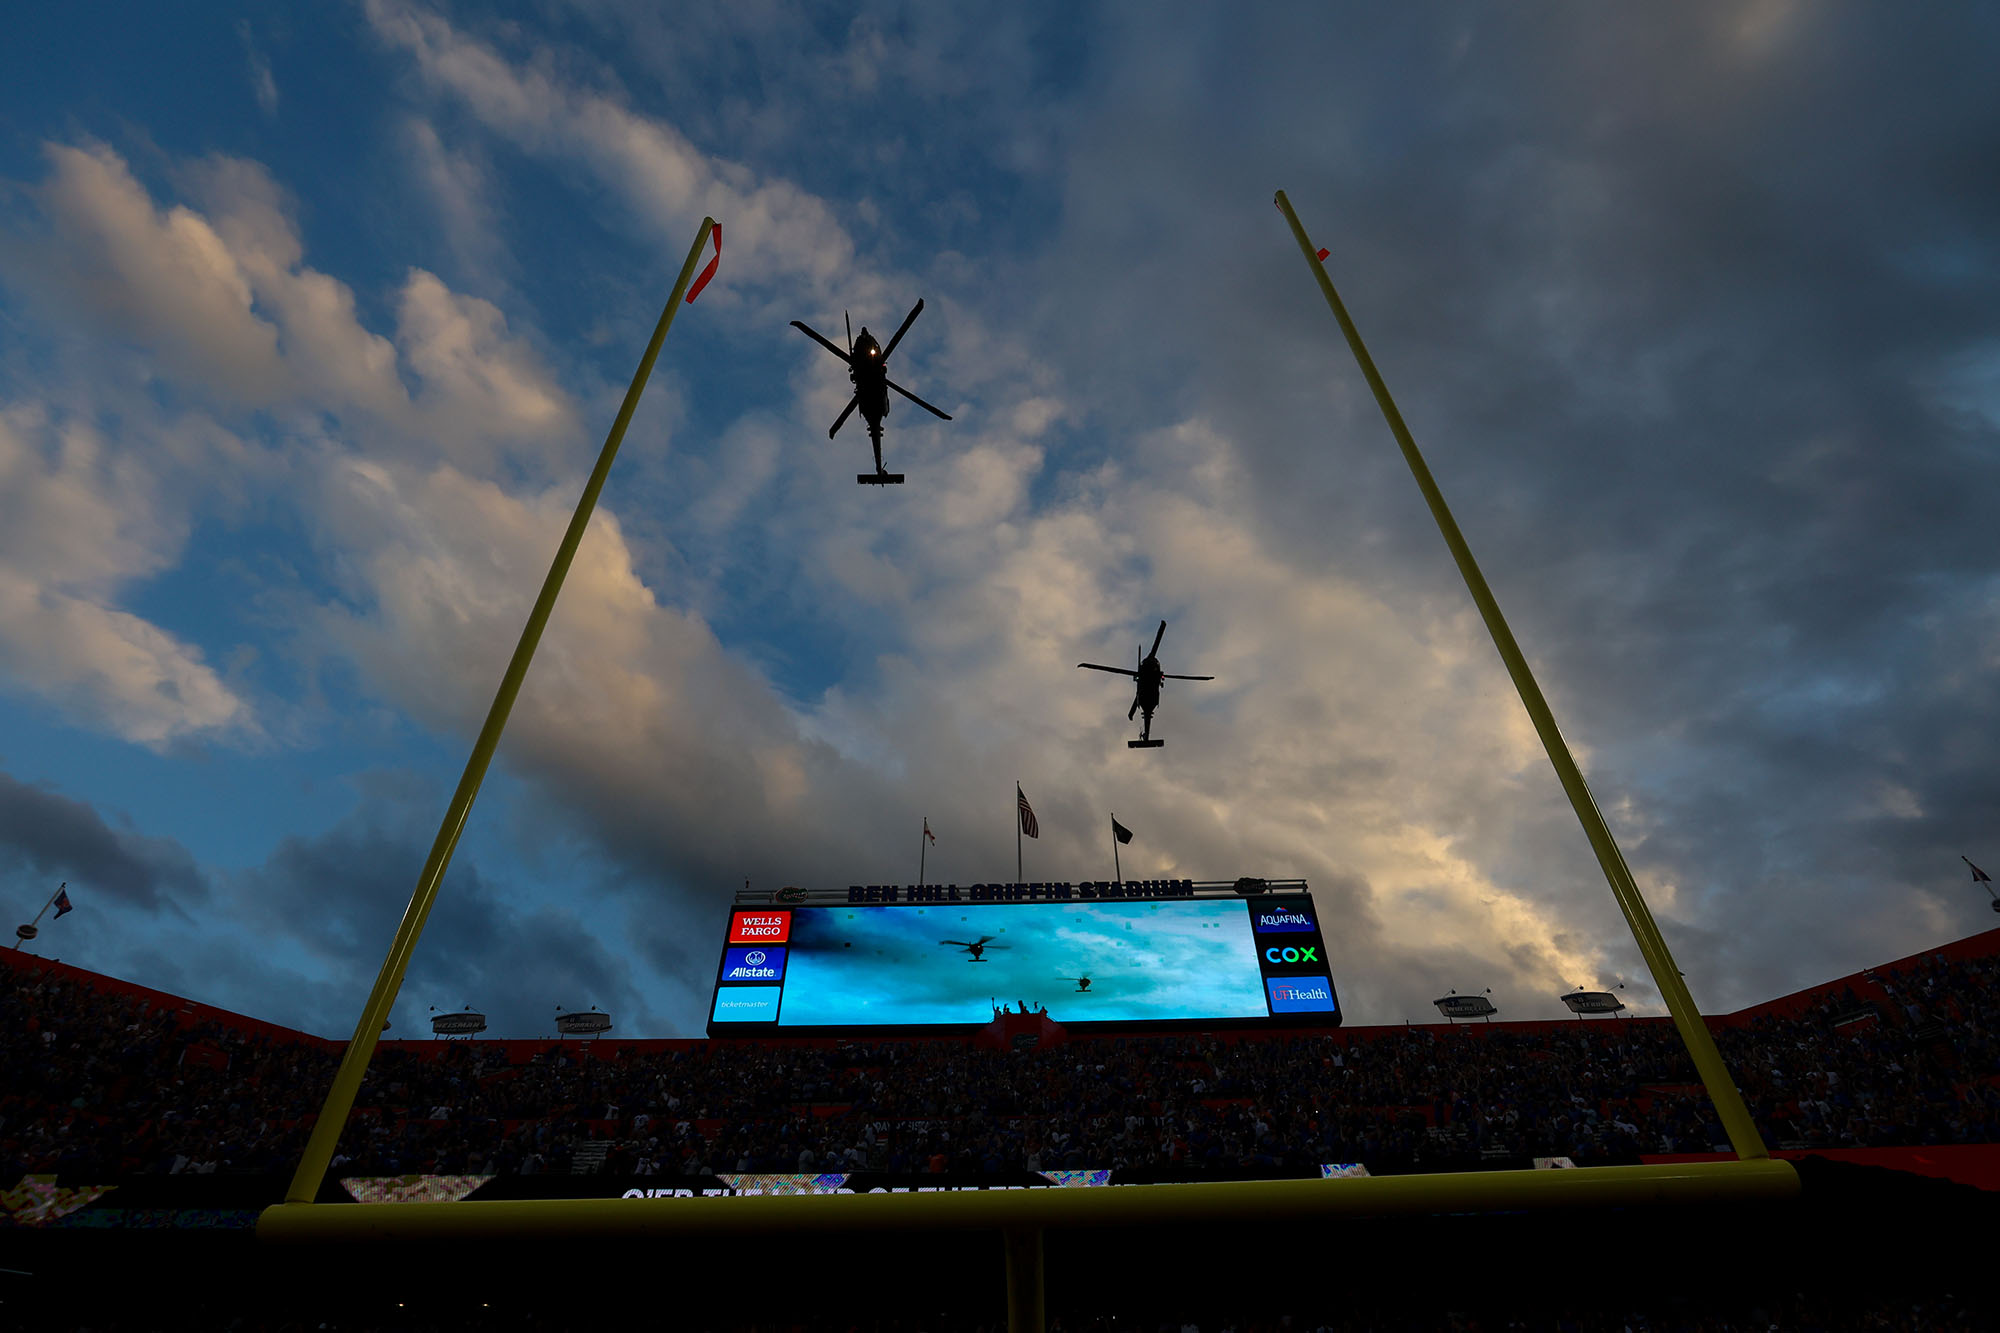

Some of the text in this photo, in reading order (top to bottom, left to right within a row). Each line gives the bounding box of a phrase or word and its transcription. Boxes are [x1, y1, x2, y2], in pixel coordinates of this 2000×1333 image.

[848, 880, 1194, 902] BEN HILL GRIFFIN STADIUM
[742, 917, 782, 925] WELLS
[1260, 914, 1308, 926] AQUAFINA
[741, 927, 781, 936] FARGO
[1265, 947, 1318, 963] COX
[729, 967, 775, 977] Allstate
